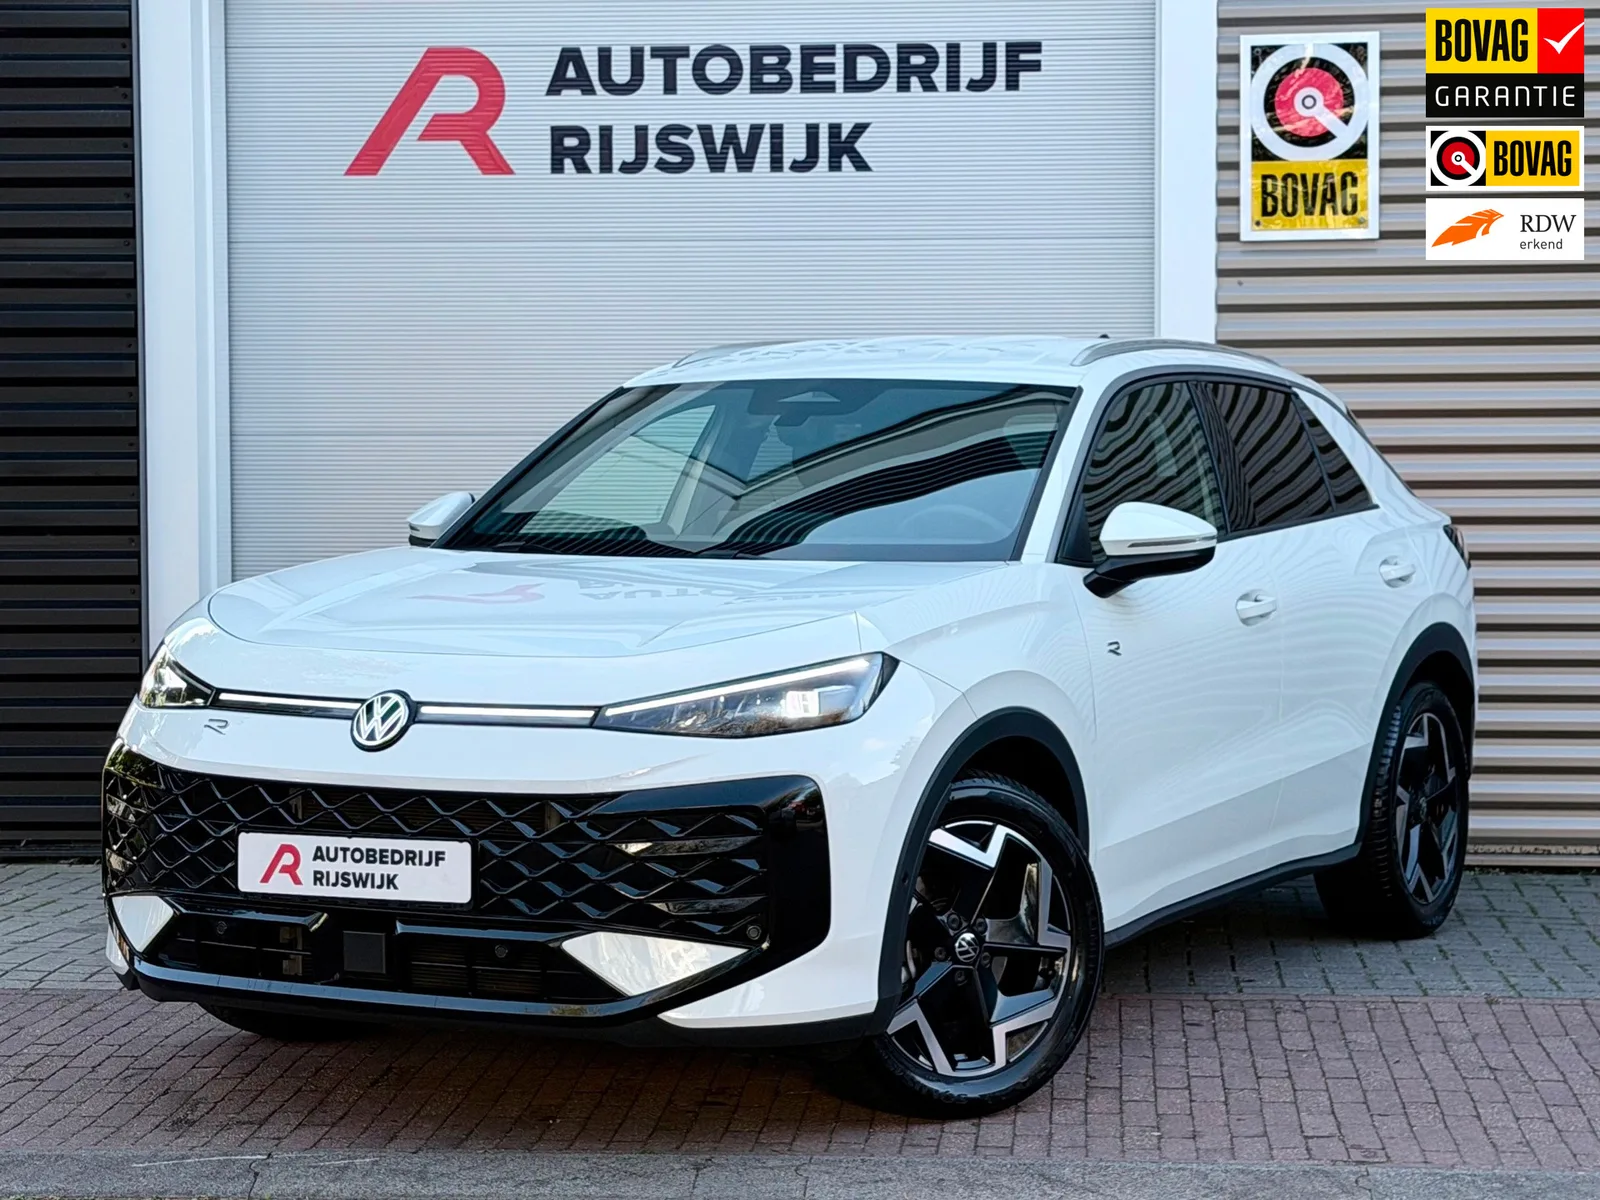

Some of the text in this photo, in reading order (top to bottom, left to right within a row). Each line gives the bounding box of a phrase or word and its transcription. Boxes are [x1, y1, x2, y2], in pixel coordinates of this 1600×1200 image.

[545, 41, 1043, 97] AUTOBEDRIJF
[550, 122, 873, 175] RIJSWIJK
[1261, 171, 1358, 218] BOVAG
[312, 845, 446, 867] AUTOBEDRIJF
[313, 870, 399, 890] RIJSWIJK
